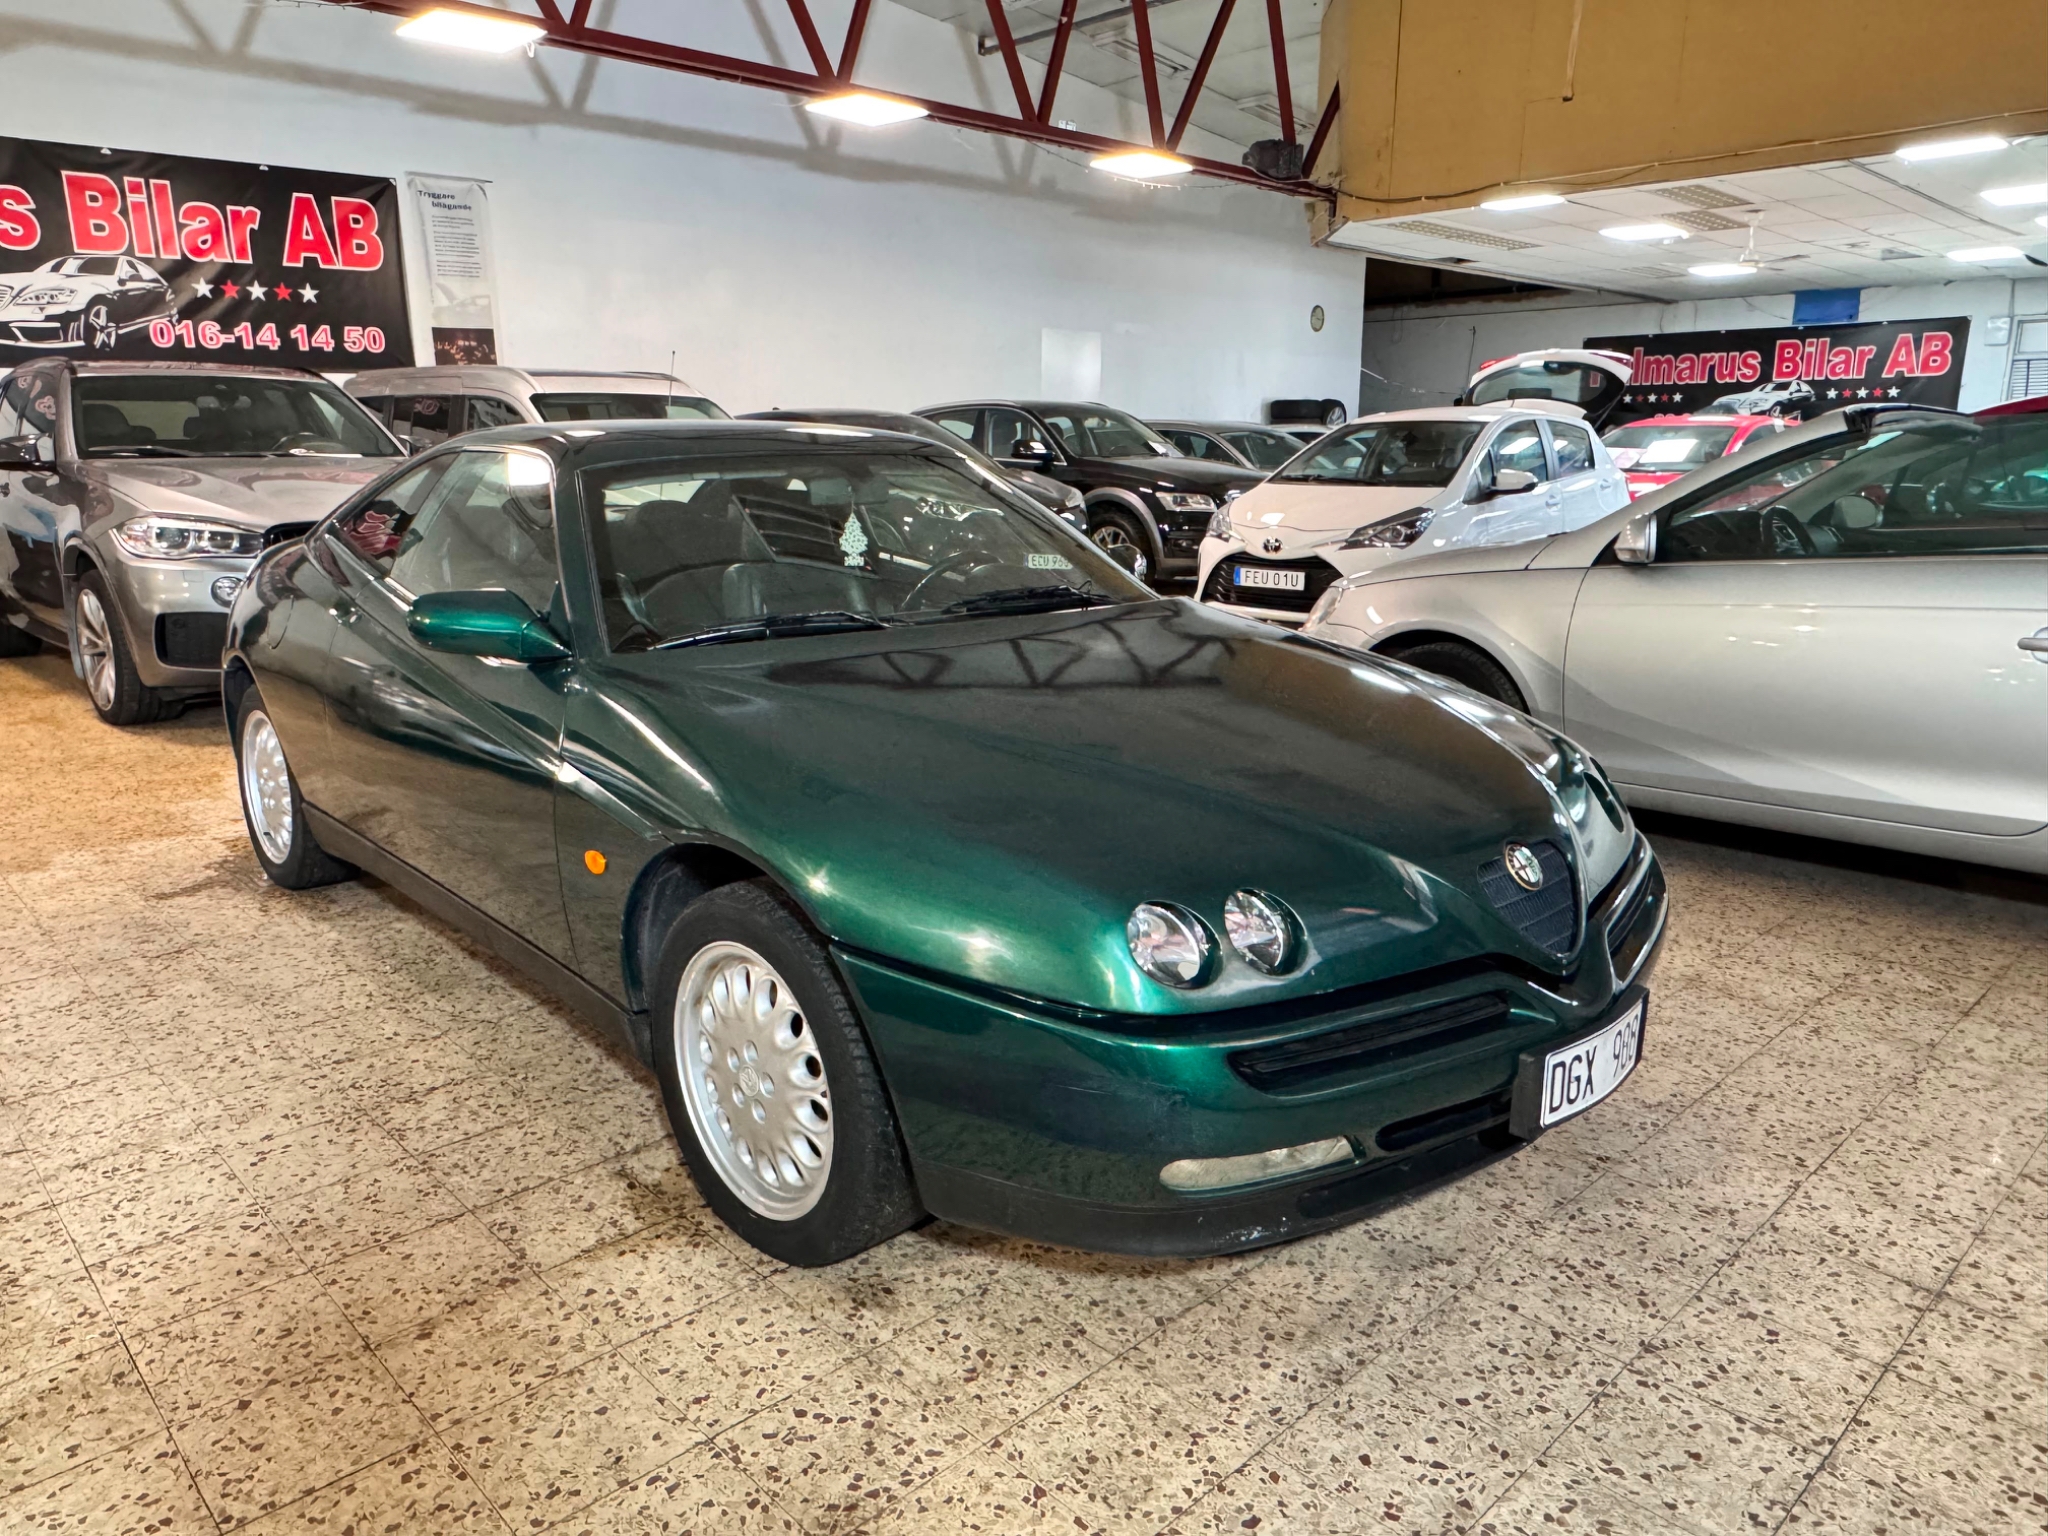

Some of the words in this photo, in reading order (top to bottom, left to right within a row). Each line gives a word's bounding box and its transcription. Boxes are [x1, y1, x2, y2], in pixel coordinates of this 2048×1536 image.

[60, 169, 261, 264] Bilar
[282, 192, 384, 271] AB
[148, 319, 281, 350] 016-14
[290, 324, 335, 352] 14
[343, 326, 386, 353] 50
[1590, 346, 1762, 388] lmarus
[1772, 337, 1877, 382] Bilar
[1881, 331, 1954, 379] AB
[1031, 554, 1050, 567] ECU
[1244, 570, 1269, 585] FEU
[1273, 572, 1299, 588] 01U
[1548, 1045, 1598, 1115] DGX
